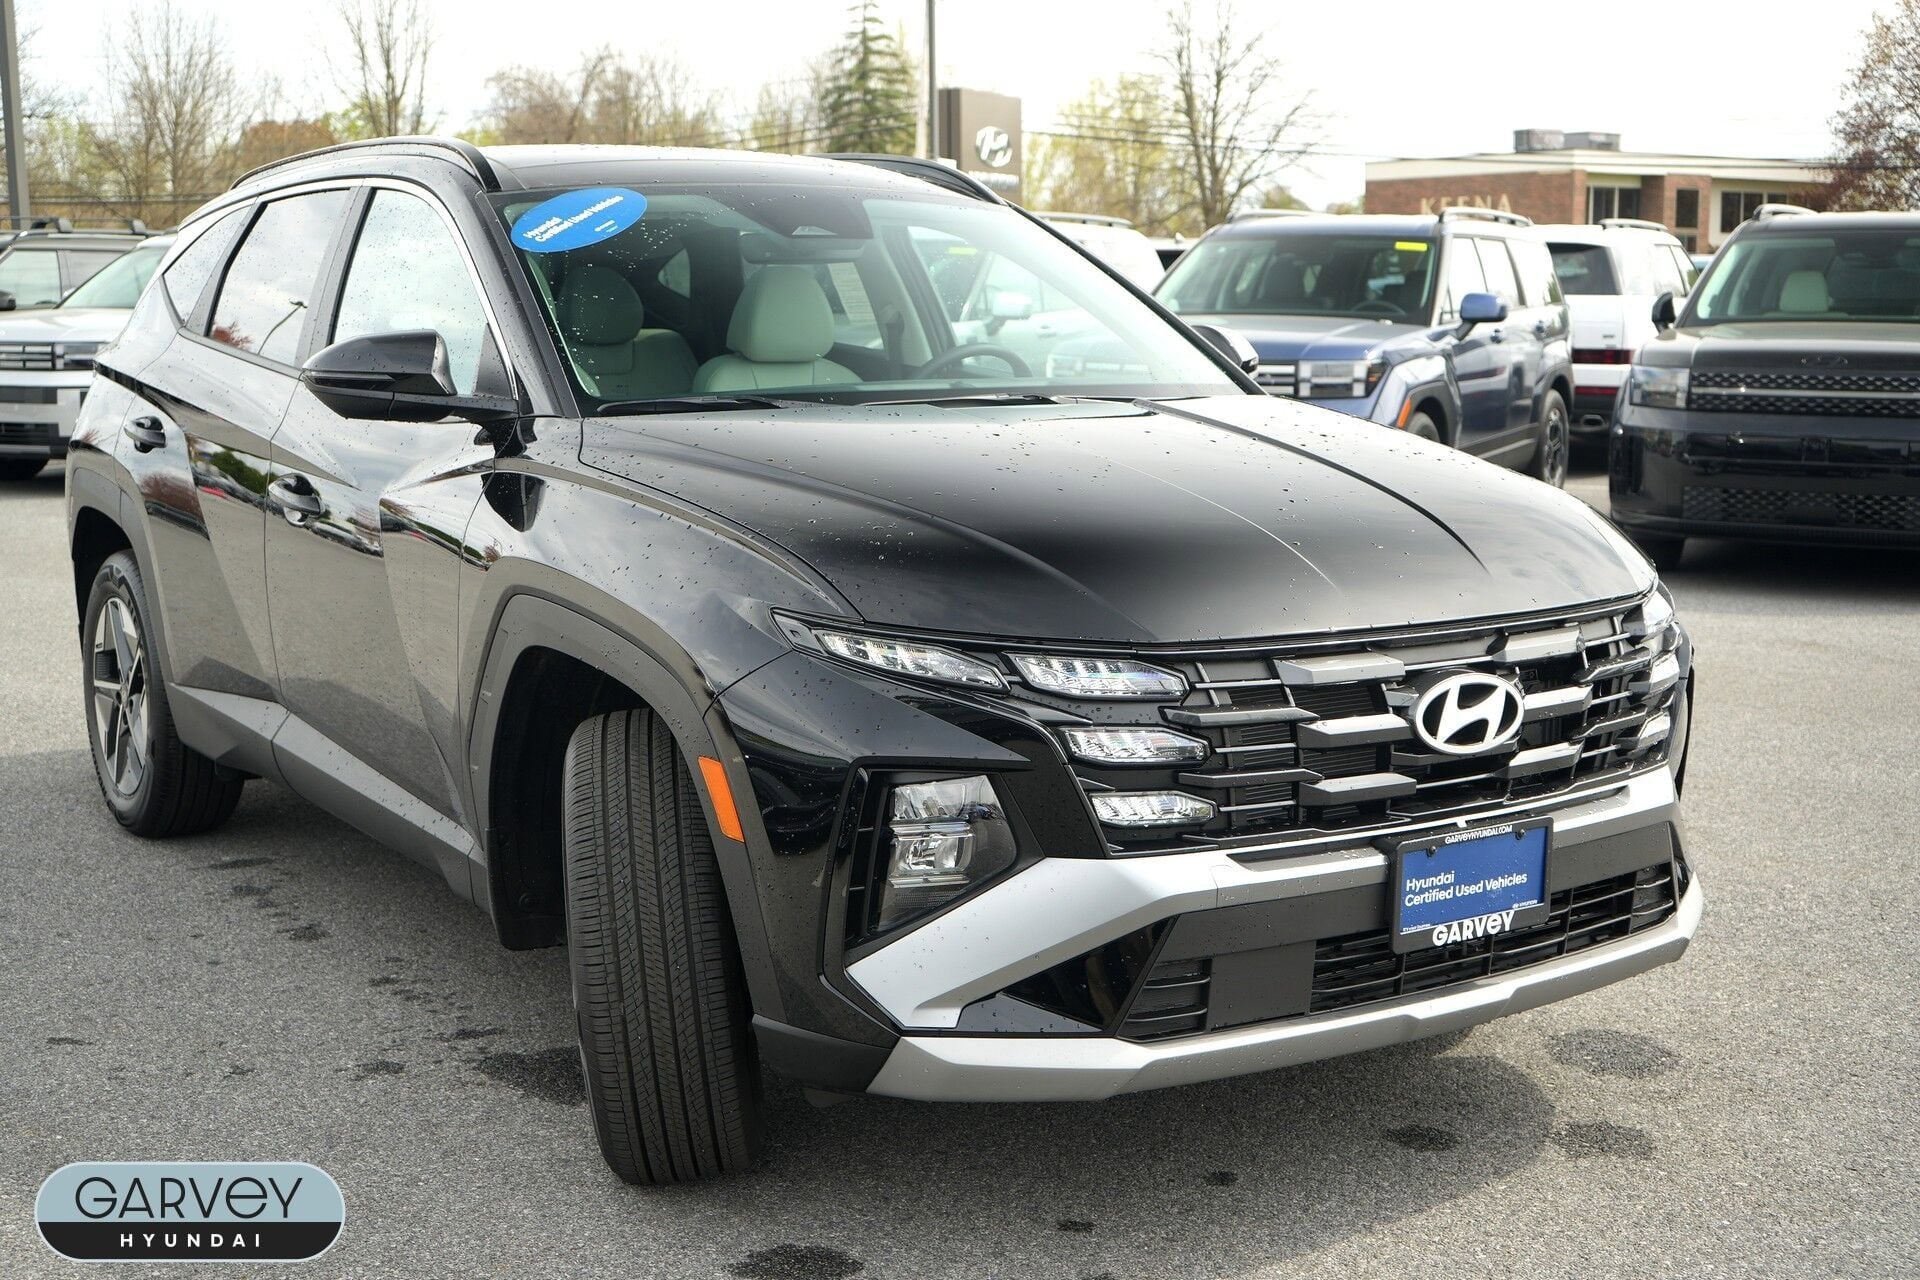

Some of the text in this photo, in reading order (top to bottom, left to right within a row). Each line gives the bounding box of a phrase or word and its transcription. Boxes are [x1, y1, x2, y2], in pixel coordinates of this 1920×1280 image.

[1421, 193, 1512, 215] KEENA
[1404, 872, 1528, 907] Certified Used Vehicles
[1405, 871, 1455, 893] Hyundai
